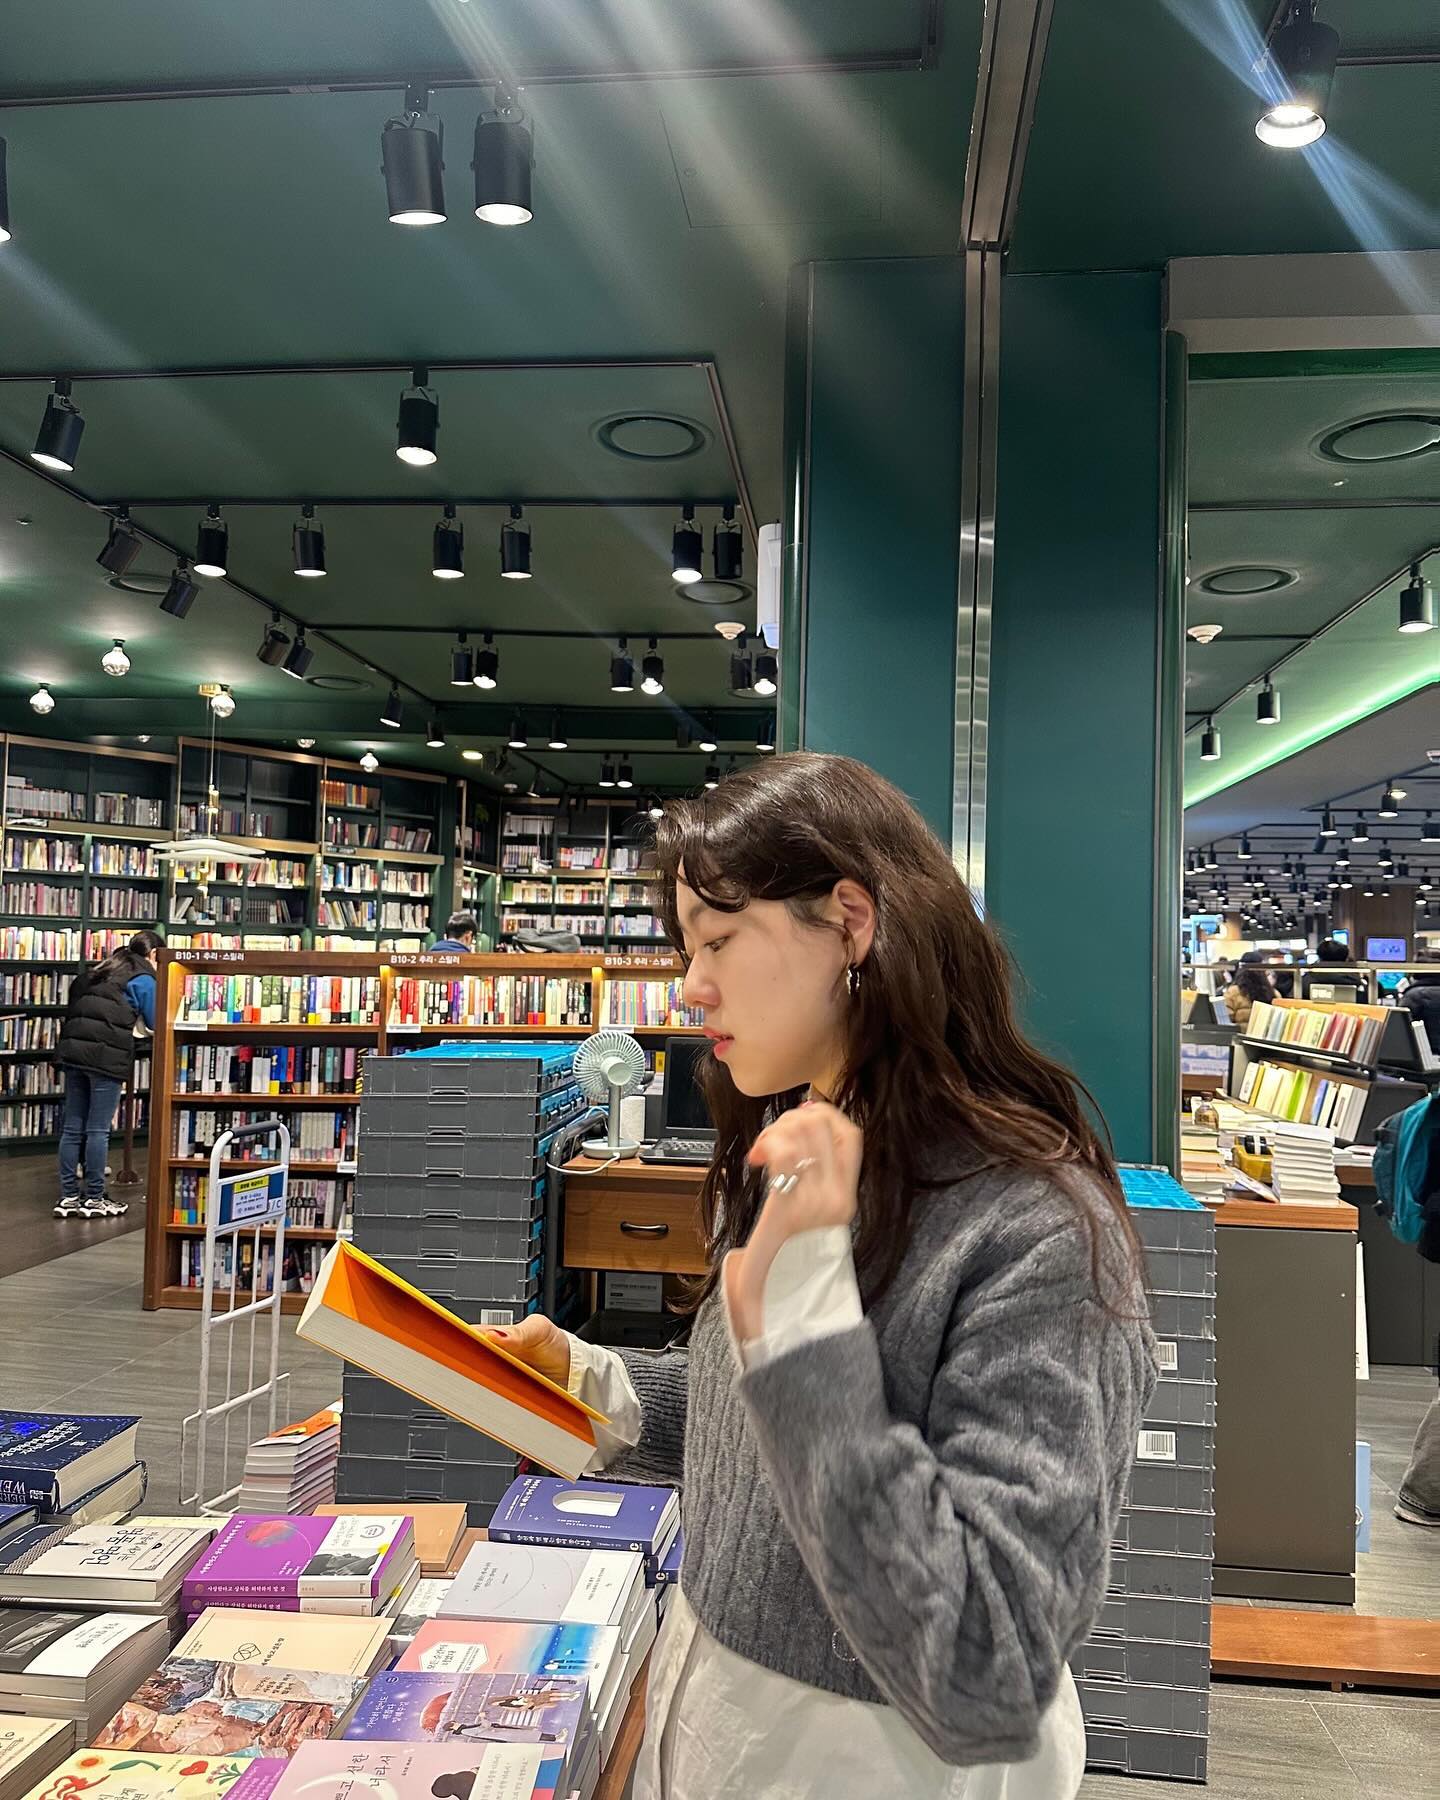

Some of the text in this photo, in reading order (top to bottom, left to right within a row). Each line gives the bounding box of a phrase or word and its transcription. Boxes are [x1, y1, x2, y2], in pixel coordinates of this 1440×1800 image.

[176, 952, 245, 961] B10-1 추리·스릴러
[390, 955, 460, 965] B10-2 추리·스릴러
[605, 956, 632, 966] B10-3
[0, 1480, 26, 1494] WE
[79, 1528, 145, 1566] 명품 명언
[366, 1696, 388, 1728] 가만히 있어도
[346, 1754, 370, 1775] 선한
[370, 1755, 398, 1787] 너라서
